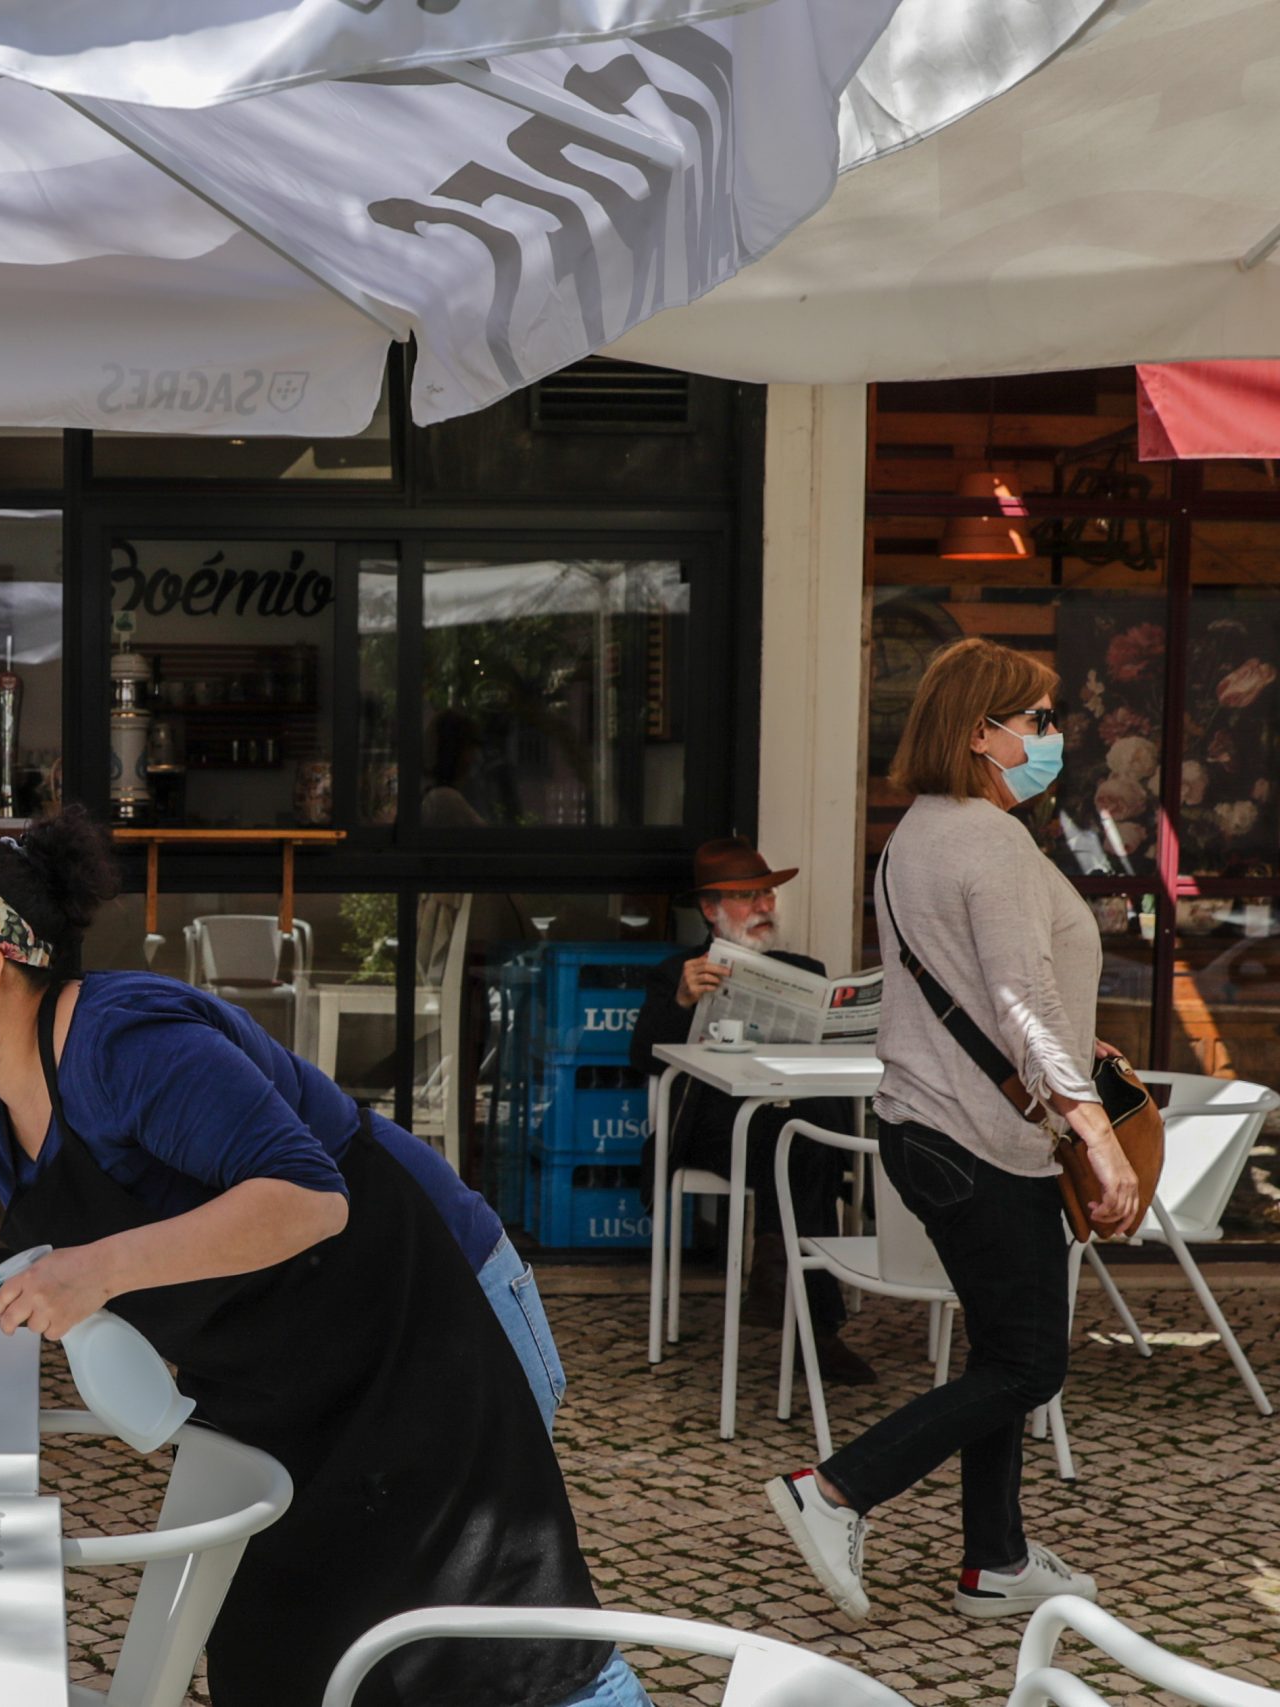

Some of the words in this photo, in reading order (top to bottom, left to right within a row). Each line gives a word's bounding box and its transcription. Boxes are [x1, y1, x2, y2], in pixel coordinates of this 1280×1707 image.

[831, 986, 856, 1008] P
[584, 1008, 640, 1031] LUS
[589, 1217, 653, 1239] LUSO
